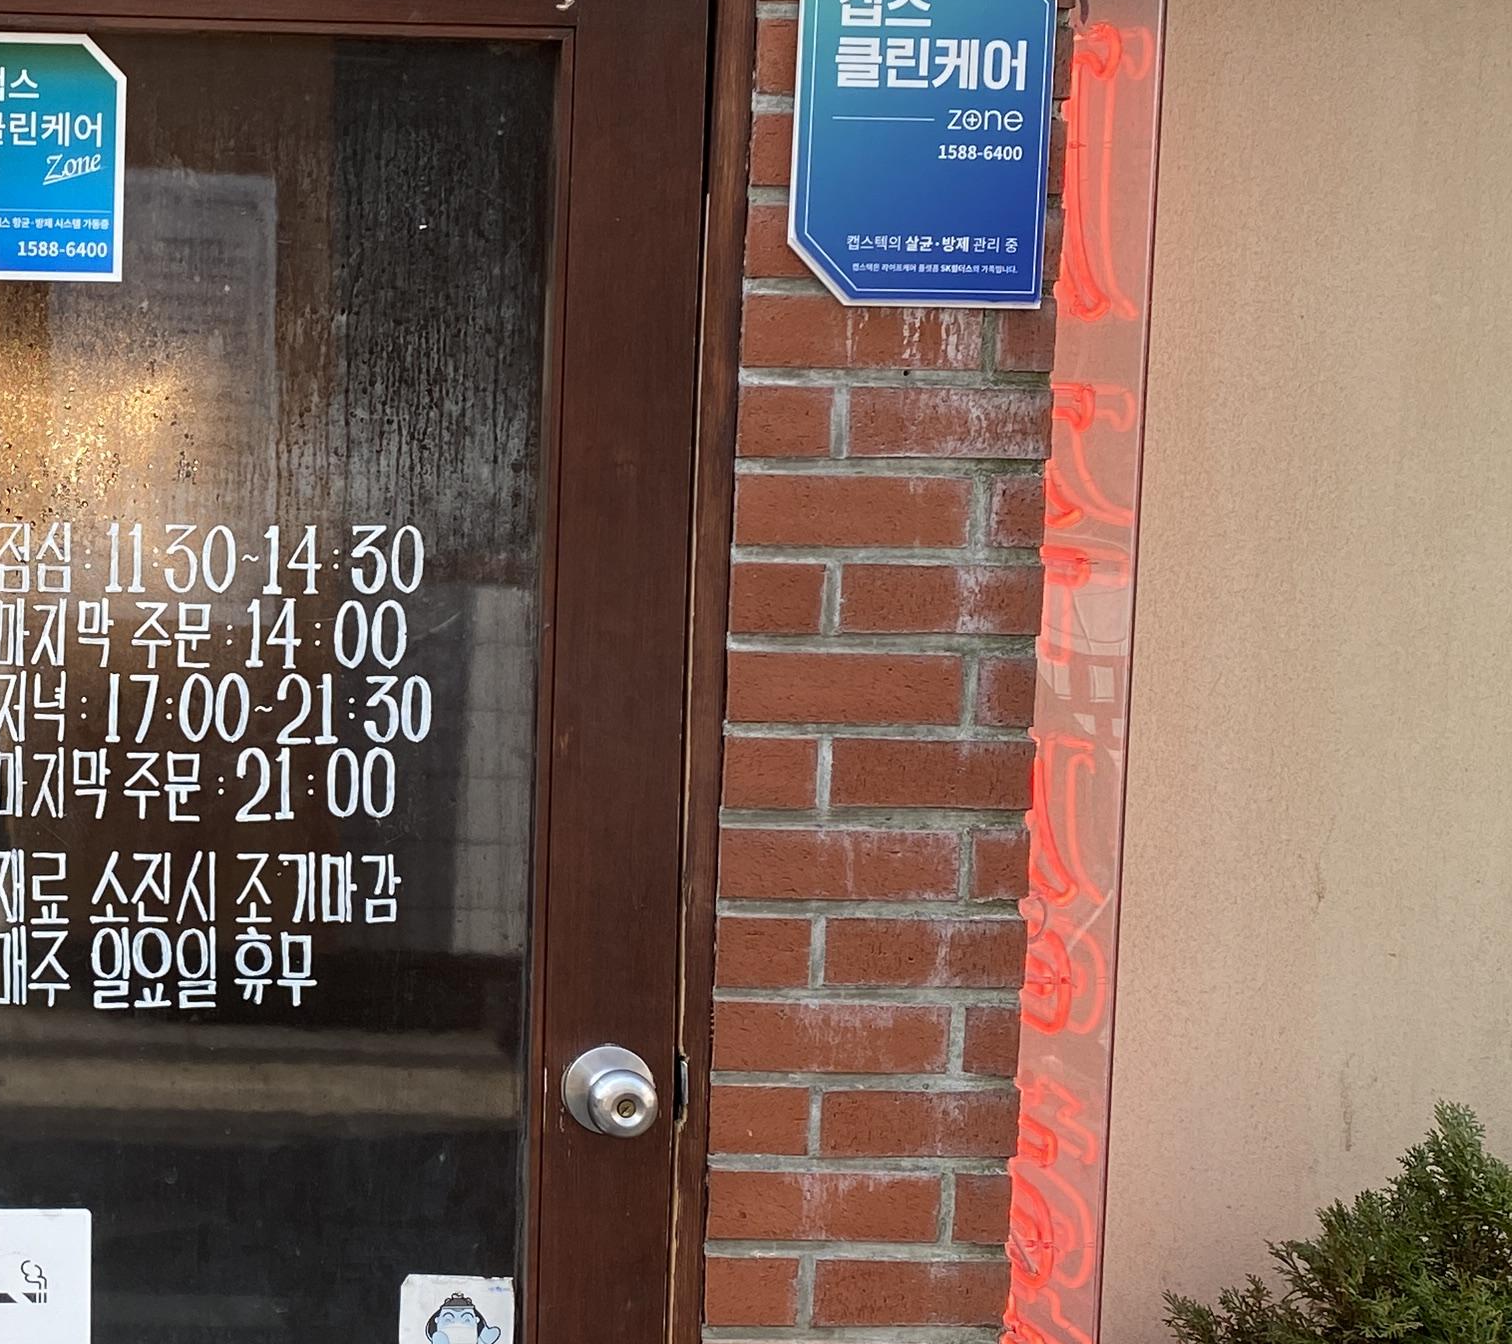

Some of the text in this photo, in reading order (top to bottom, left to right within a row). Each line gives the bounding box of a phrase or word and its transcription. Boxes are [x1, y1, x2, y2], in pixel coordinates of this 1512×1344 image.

[835, 36, 1028, 92] 클린케어
[42, 153, 103, 186] Zone
[938, 144, 1023, 162] 1588-6400
[17, 241, 108, 257] 1588-6400
[846, 234, 901, 251] 캡스텍의
[973, 236, 1000, 253] 관리
[1005, 237, 1018, 253] 중
[90, 850, 217, 924] 소진시
[90, 926, 217, 1009] 일요일
[234, 927, 318, 1007] 휴무
